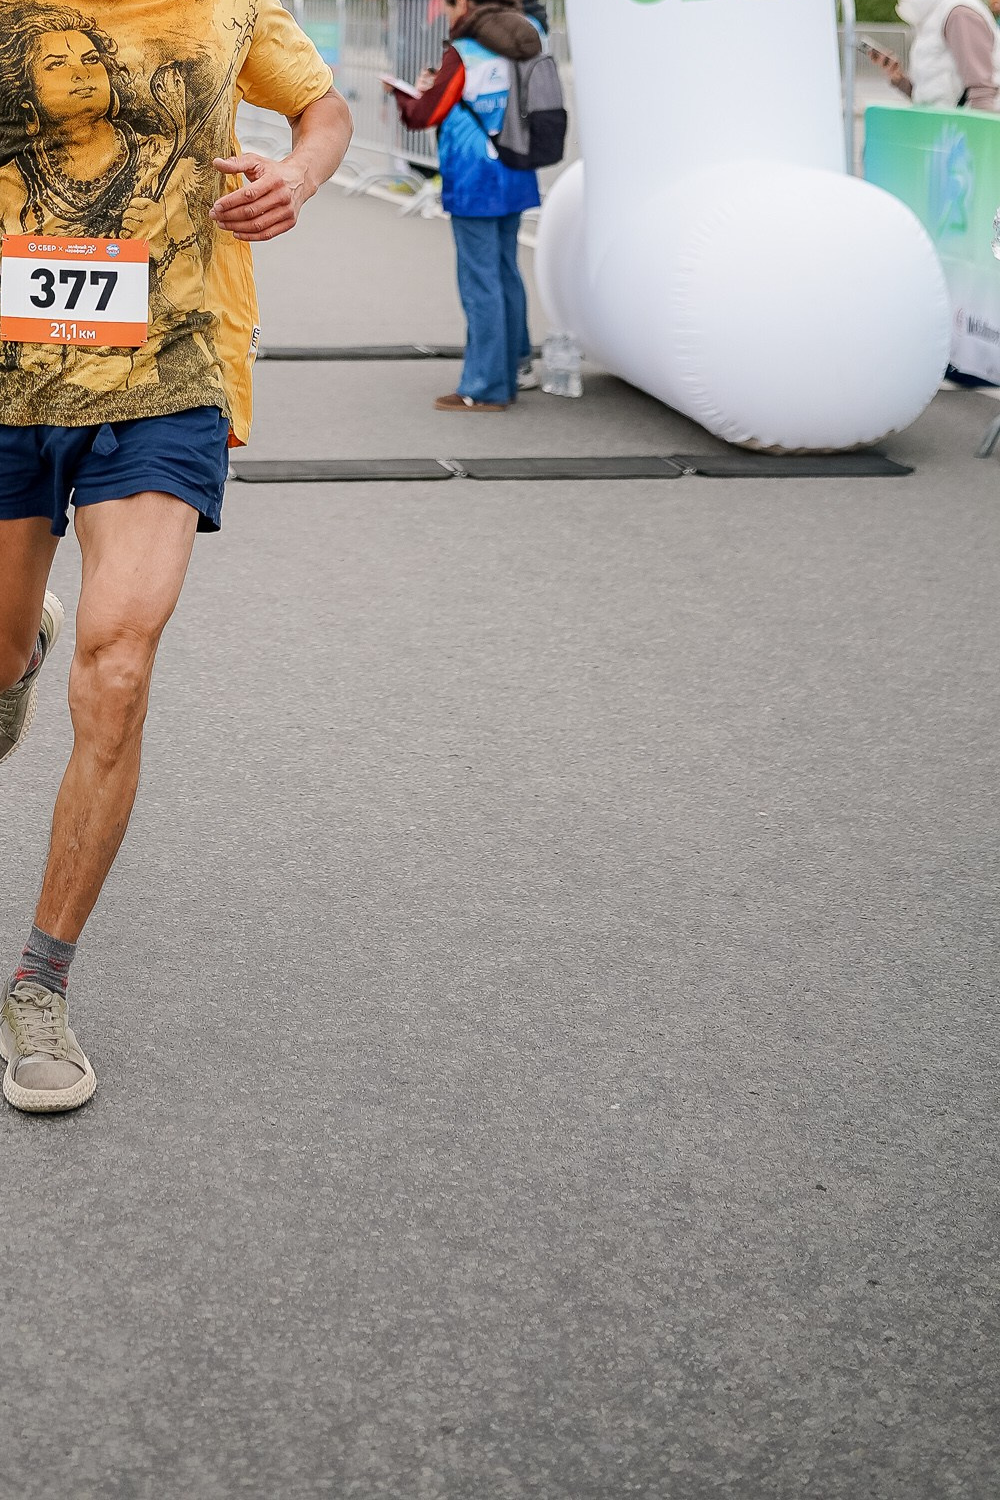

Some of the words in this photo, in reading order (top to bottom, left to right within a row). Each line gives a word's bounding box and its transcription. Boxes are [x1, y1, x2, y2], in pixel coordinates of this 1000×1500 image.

[37, 244, 57, 252] СБЕР
[29, 268, 118, 311] 377
[50, 322, 77, 341] 21,1
